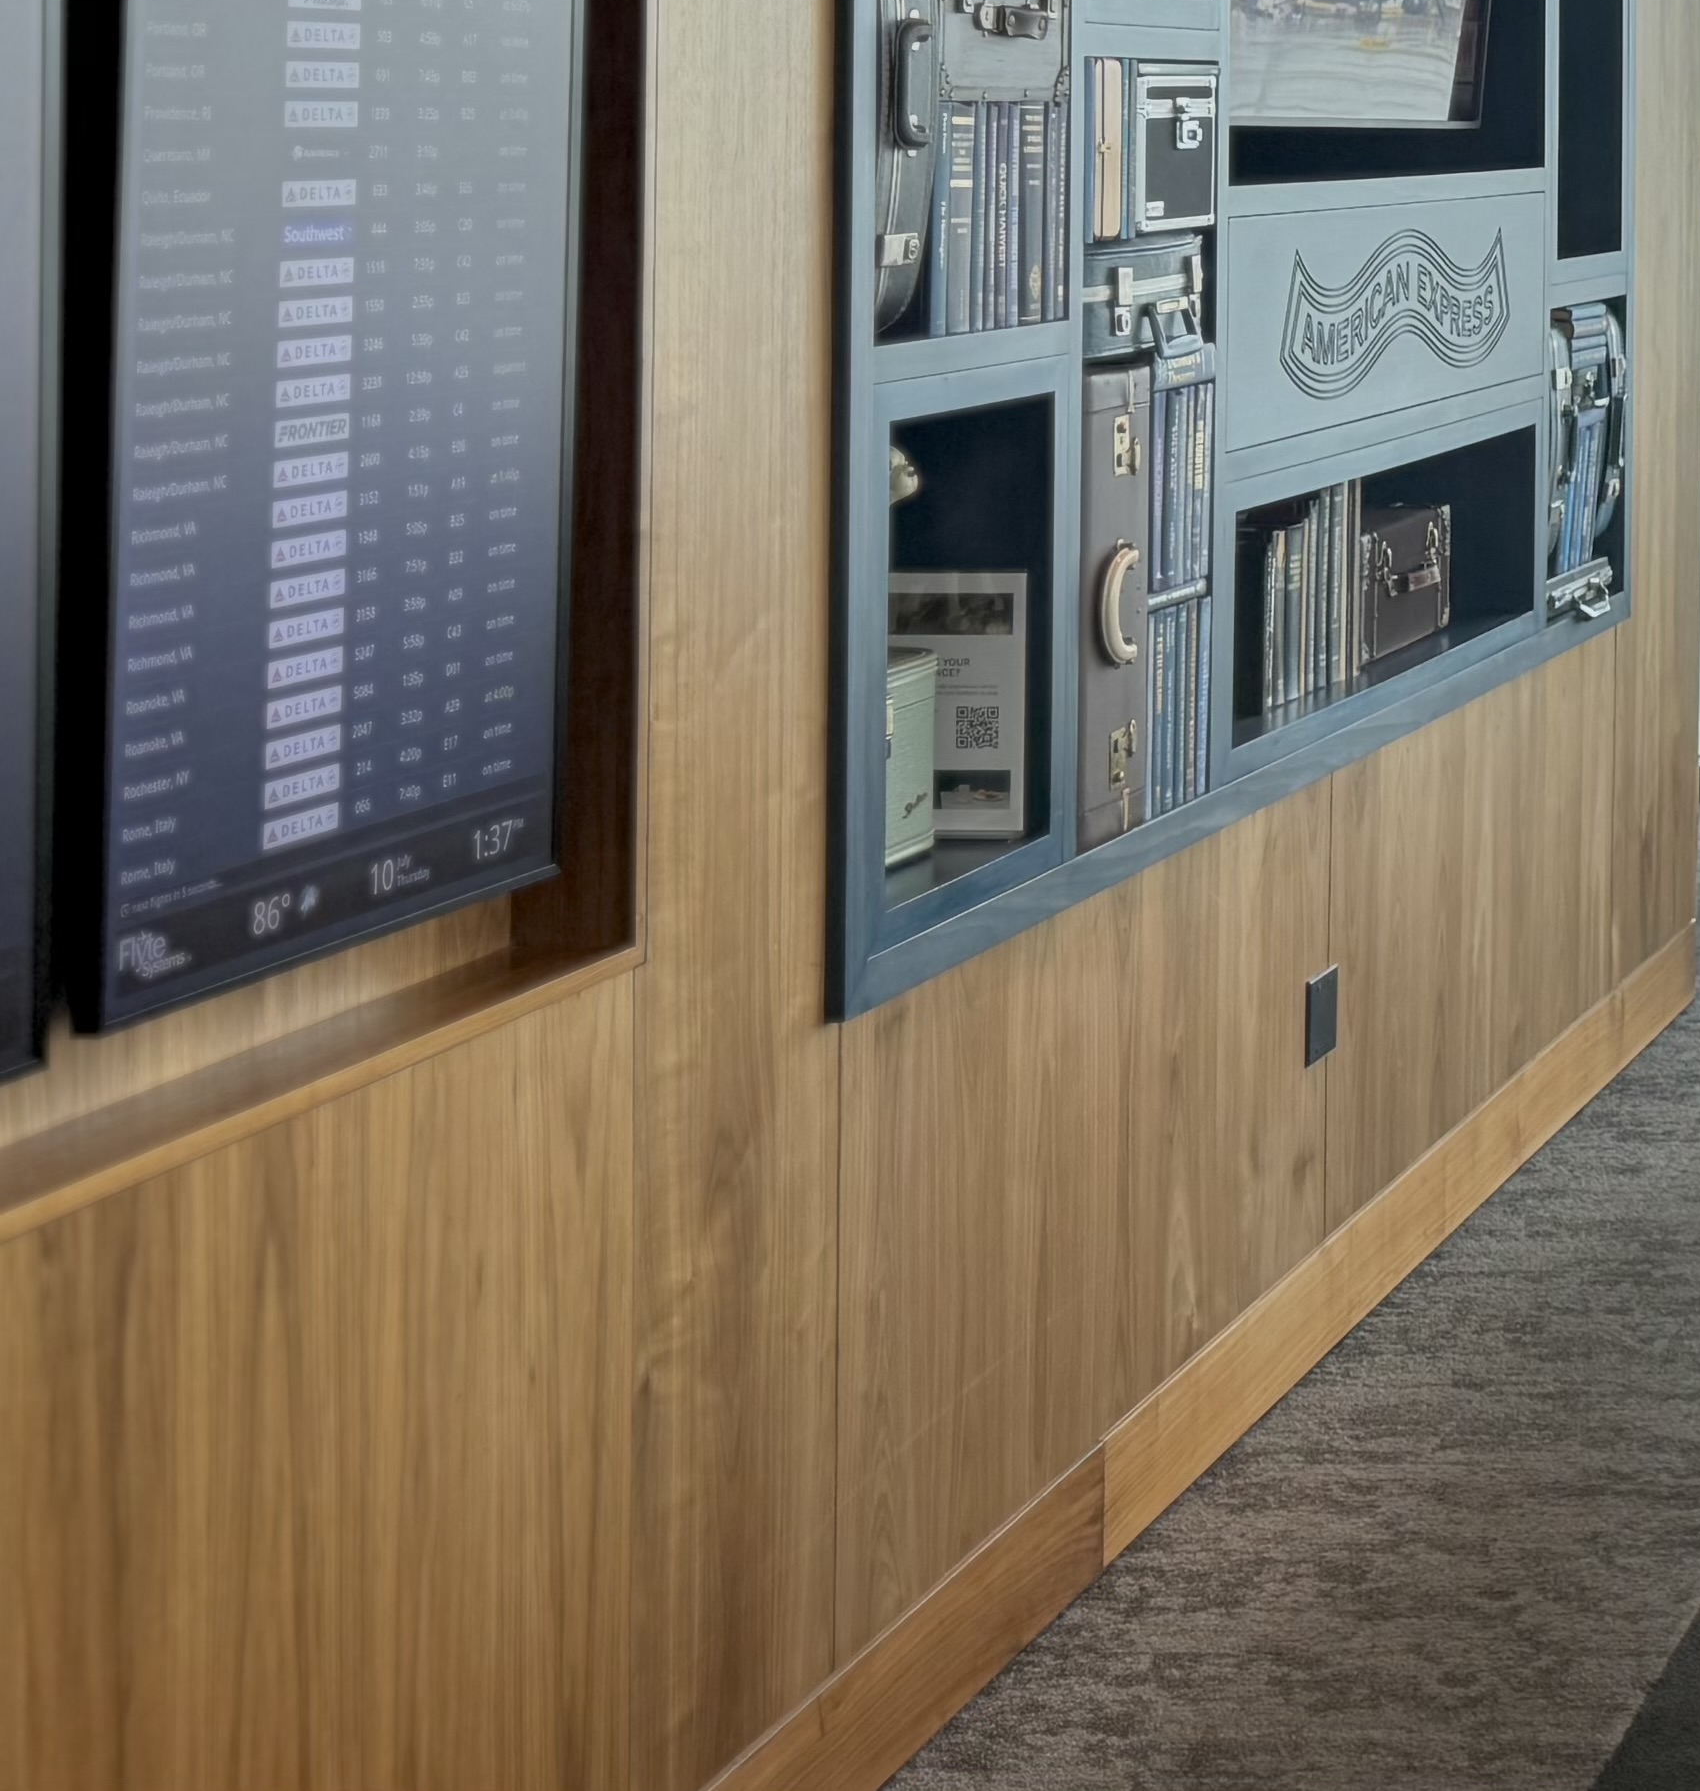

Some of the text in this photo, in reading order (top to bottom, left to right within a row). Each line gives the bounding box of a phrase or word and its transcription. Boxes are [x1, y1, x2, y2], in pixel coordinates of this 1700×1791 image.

[303, 27, 346, 43] DELTA
[302, 66, 345, 82] DELTA
[301, 106, 343, 121] DELTA
[299, 184, 341, 200] DELTA
[220, 228, 234, 244] NC
[283, 222, 344, 242] Southwest
[219, 269, 233, 285] NC
[296, 263, 339, 280] DELTA
[218, 310, 232, 326] NC
[295, 302, 338, 320] DELTA
[1300, 260, 1494, 366] AMERICAN EXPRESS
[217, 351, 231, 367] NC
[294, 341, 337, 360] DELTA
[216, 392, 230, 408] NC
[293, 380, 336, 400] DELTA
[214, 433, 229, 450] NC
[277, 416, 347, 443] FRONTIER
[213, 474, 228, 491] NC
[291, 458, 333, 480] DELTA
[130, 523, 181, 548] Richmond,
[182, 520, 197, 537] VA
[290, 498, 332, 519] DELTA
[129, 564, 180, 591] Richmond,
[181, 561, 196, 579] VA
[288, 537, 331, 559] DELTA
[128, 606, 179, 634] Richmond,
[180, 603, 195, 621] VA
[287, 576, 330, 599] DELTA
[356, 567, 377, 585] 3166
[127, 648, 178, 676] Richmond,
[179, 645, 194, 663] VA
[286, 616, 329, 639] DELTA
[944, 657, 971, 668] YOUR
[125, 692, 170, 719] Roanoke,
[170, 688, 186, 706] VA
[285, 655, 328, 679] DELTA
[124, 734, 169, 762] Roanoke,
[169, 730, 185, 748] VA
[284, 694, 327, 719] DELTA
[123, 774, 174, 805] Rochester,
[283, 734, 325, 760] DELTA
[122, 822, 152, 848] Rome,
[154, 815, 176, 839] Italy
[282, 773, 324, 800] DELTA
[355, 759, 372, 778] 214
[121, 864, 151, 890] Rome,
[153, 857, 175, 882] Italy
[280, 812, 323, 840] DELTA
[472, 821, 514, 861] 1:37
[368, 859, 395, 897] 10
[252, 893, 292, 936] 86°
[119, 936, 167, 977] Flyte
[142, 952, 187, 979] Systems
